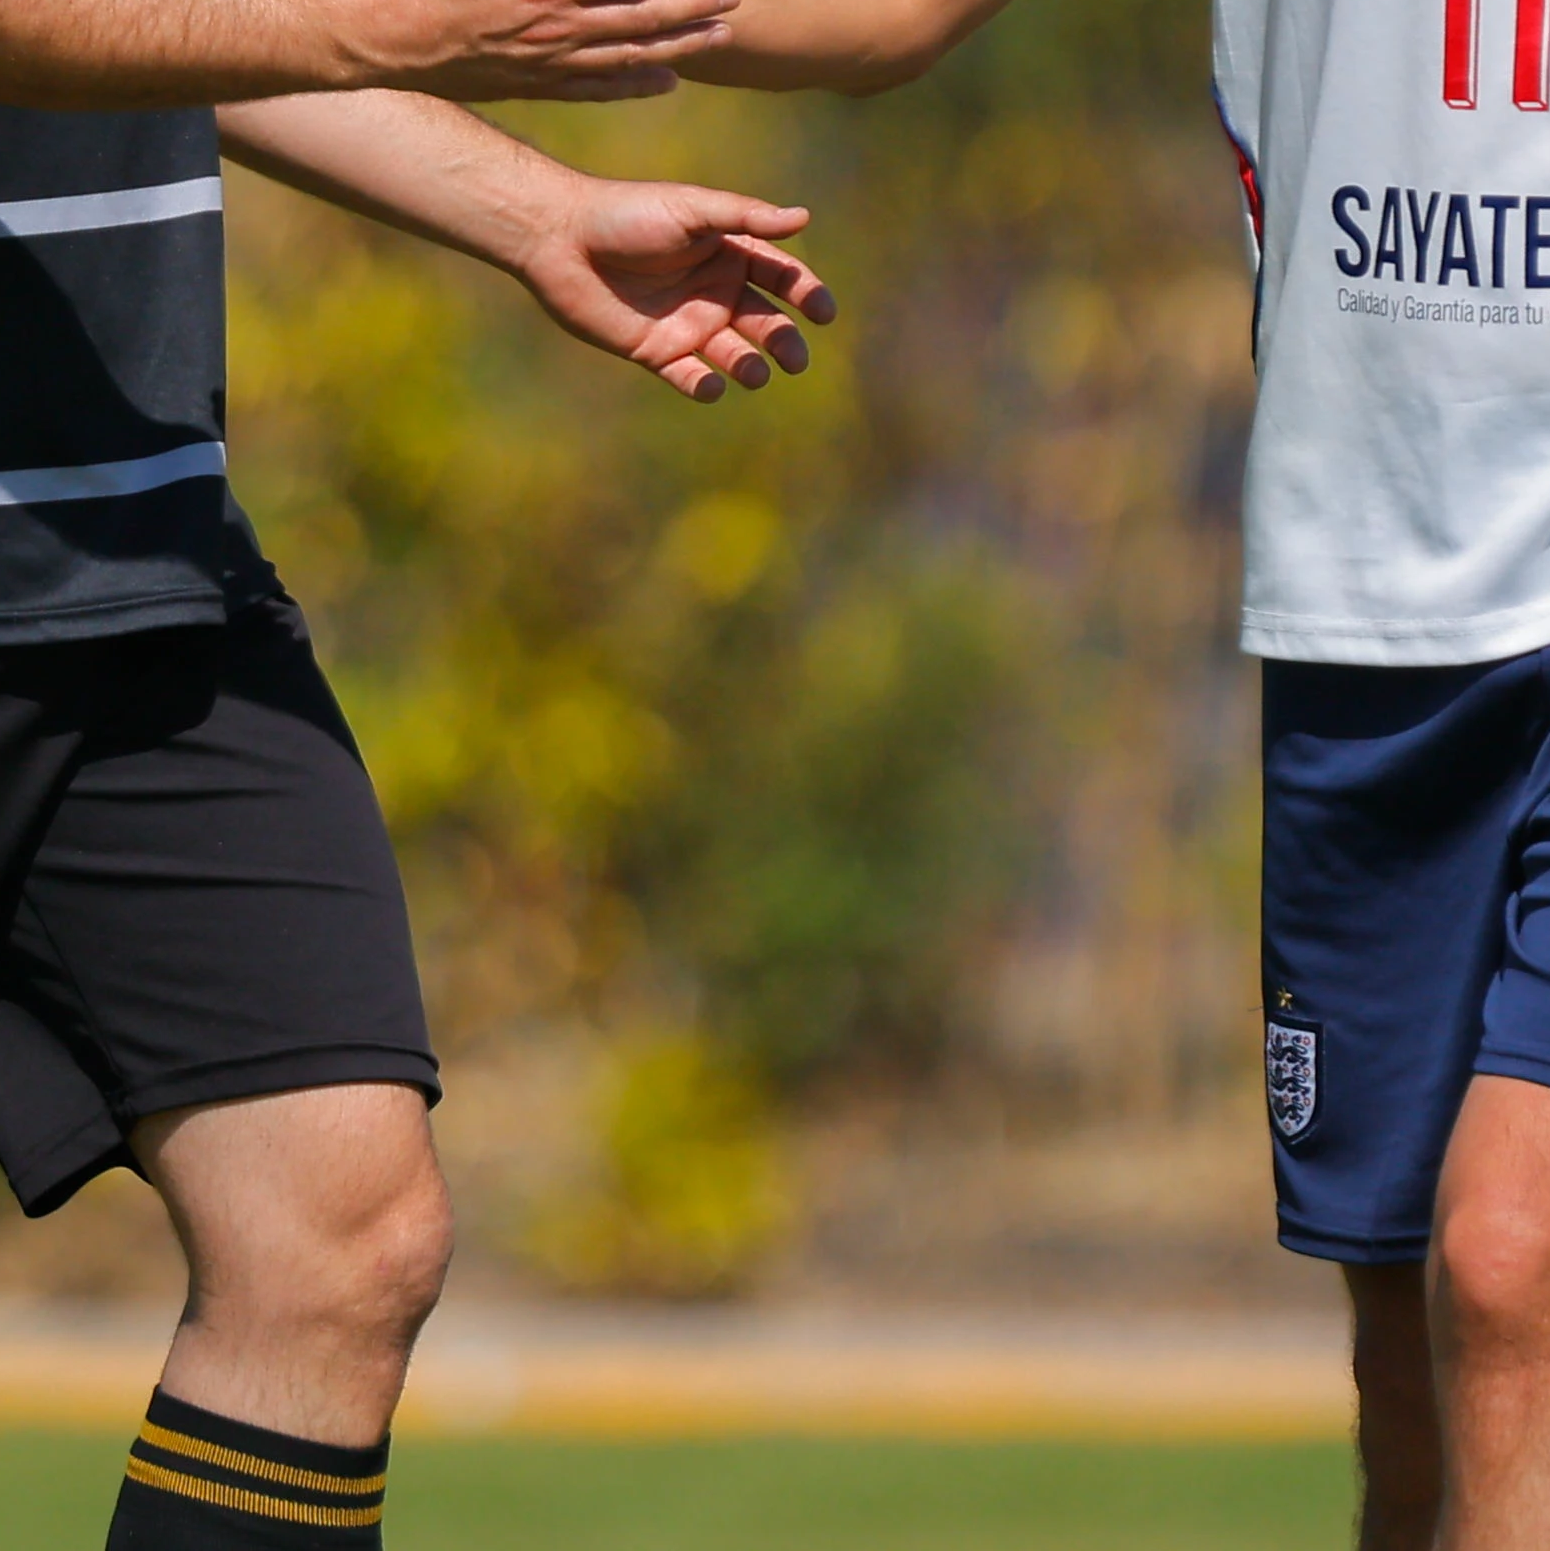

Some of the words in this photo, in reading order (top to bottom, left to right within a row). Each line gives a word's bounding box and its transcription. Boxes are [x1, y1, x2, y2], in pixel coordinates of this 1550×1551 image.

[1337, 287, 1388, 317] Calidad
[1390, 299, 1400, 323] y
[1403, 295, 1475, 324] Garantía
[1479, 304, 1520, 328] para
[1525, 301, 1544, 326] tu
